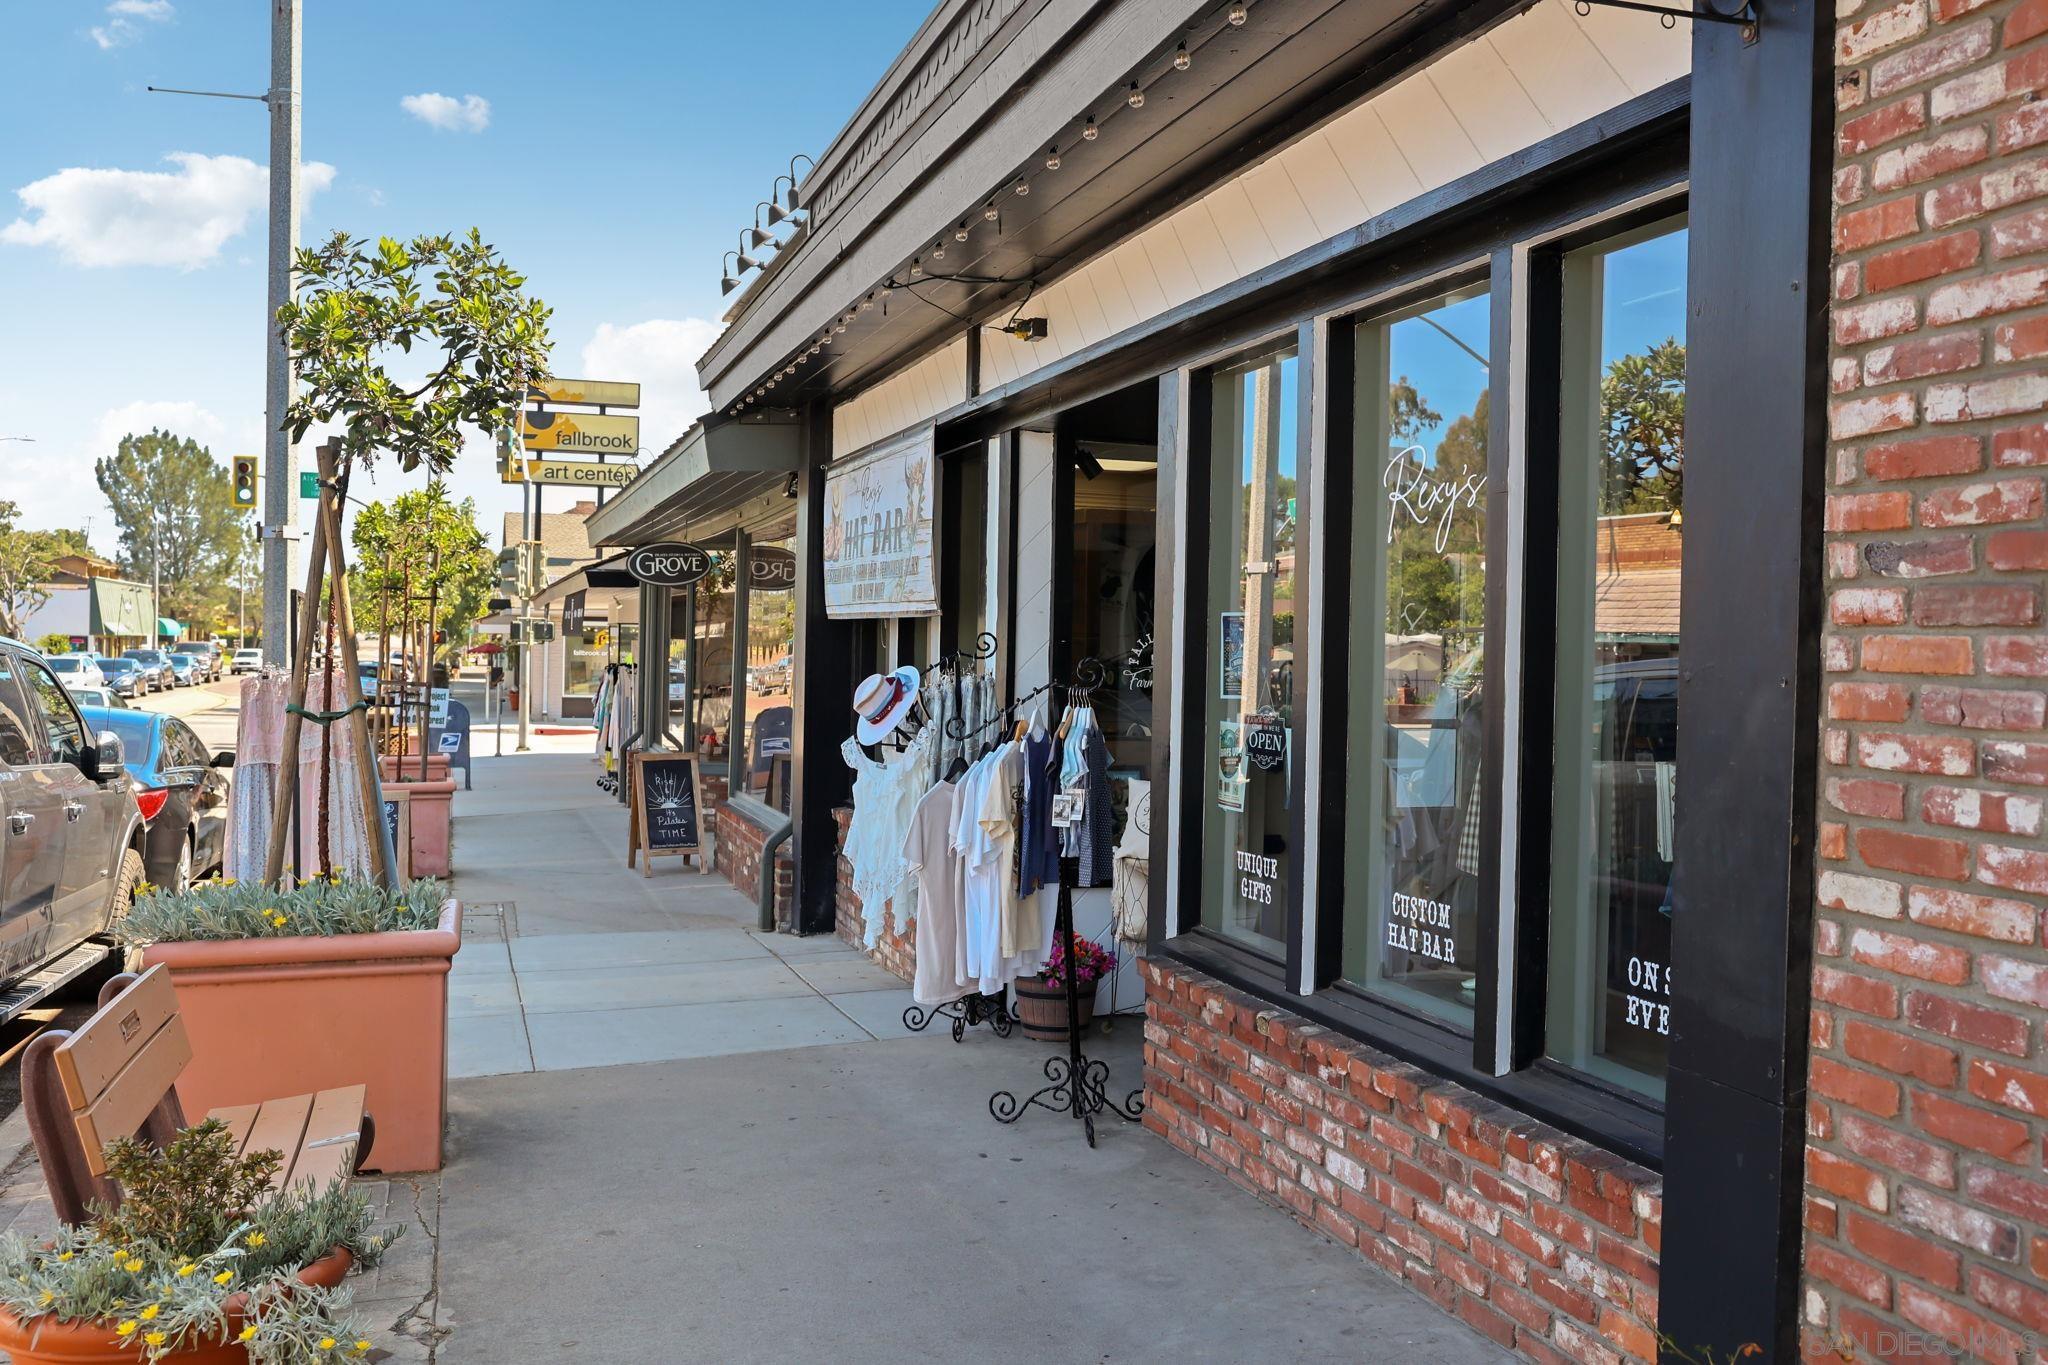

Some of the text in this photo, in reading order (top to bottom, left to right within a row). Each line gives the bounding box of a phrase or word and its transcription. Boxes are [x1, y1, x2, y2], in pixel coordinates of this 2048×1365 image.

[555, 431, 633, 448] fallbrook
[544, 466, 632, 482] art center
[1383, 445, 1488, 554] Rexy's
[844, 507, 904, 561] HAT BAR
[635, 552, 702, 576] GROVE
[1248, 731, 1283, 752] OPEN
[656, 776, 675, 786] Rise
[656, 816, 688, 826] Pilates
[658, 828, 687, 838] TIME
[1236, 850, 1278, 880] UNIQUE
[1241, 876, 1272, 905] GIFTS
[1391, 891, 1451, 930] CUSTOM
[1387, 922, 1456, 964] HAT BAR
